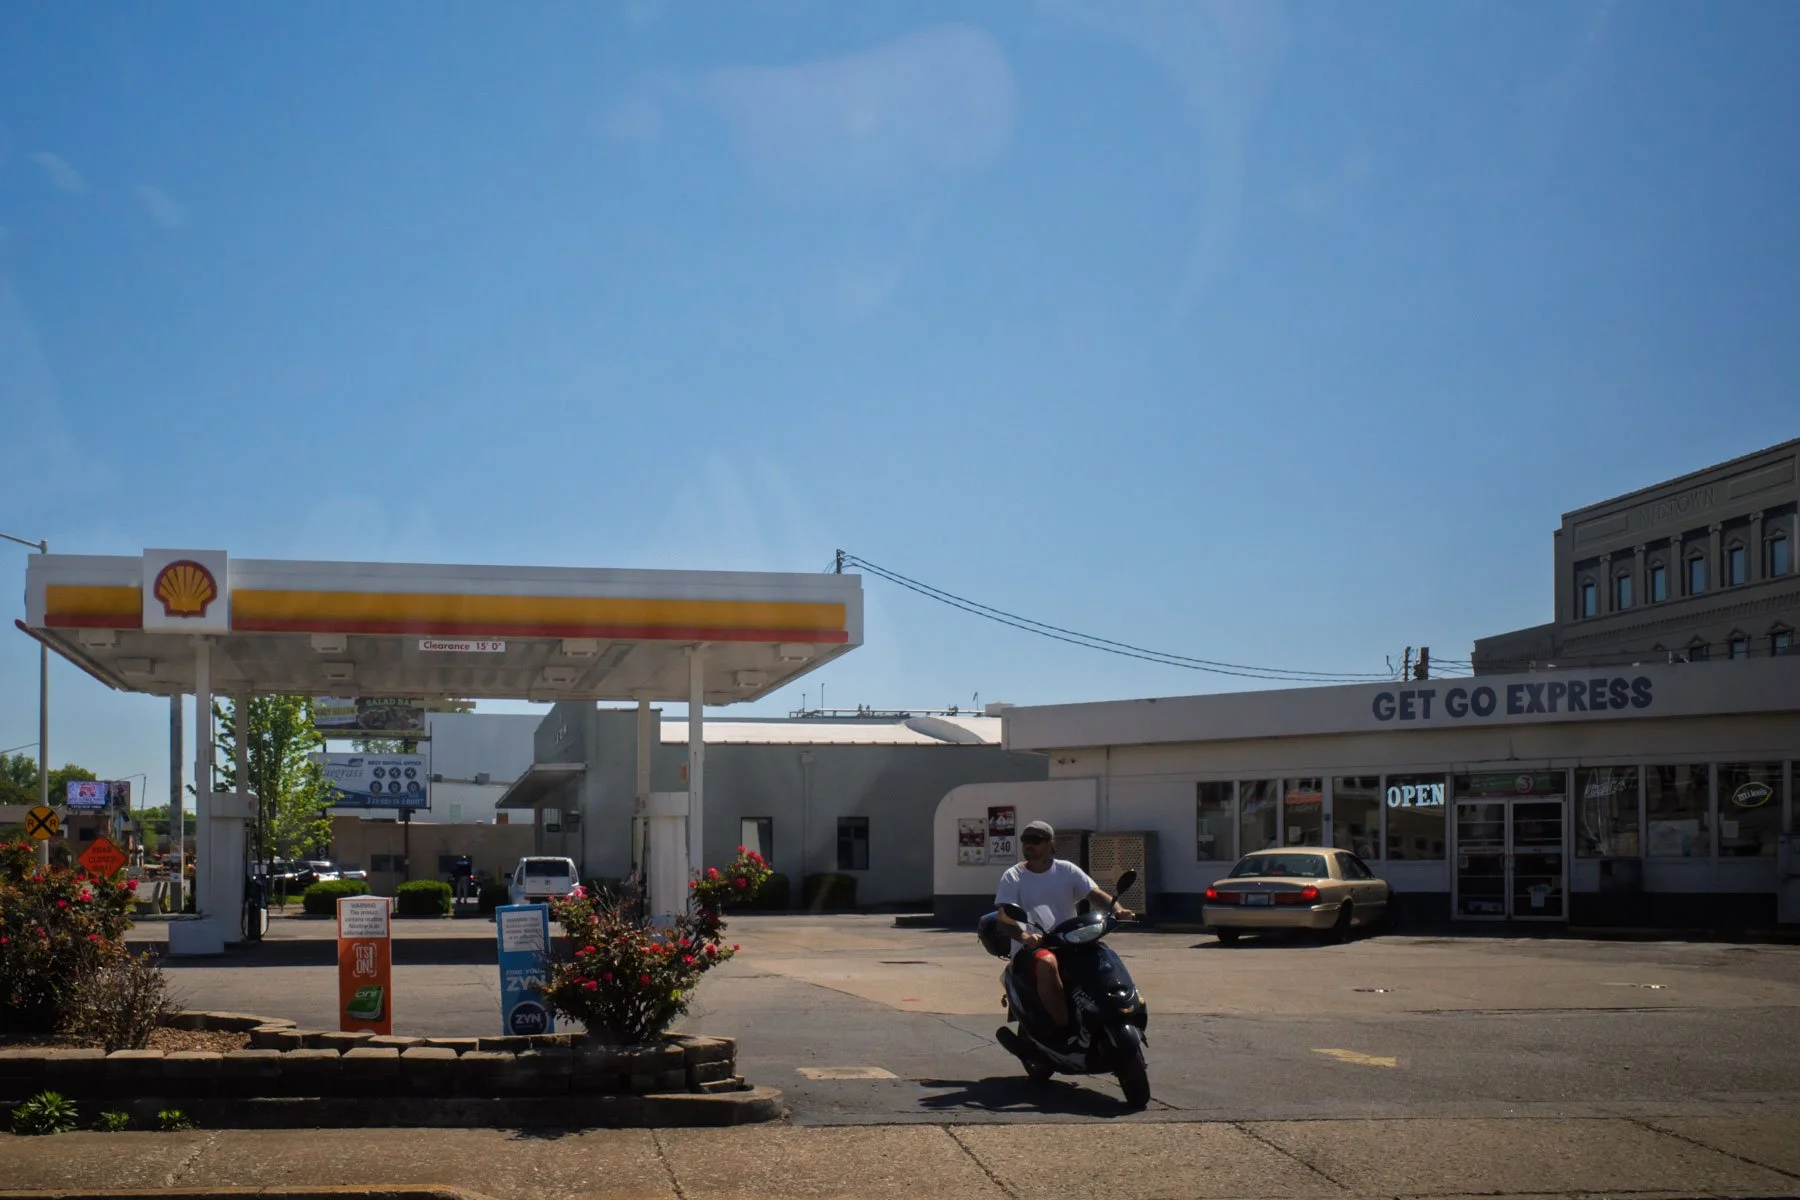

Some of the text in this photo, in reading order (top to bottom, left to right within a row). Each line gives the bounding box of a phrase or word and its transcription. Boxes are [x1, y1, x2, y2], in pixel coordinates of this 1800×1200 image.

[423, 641, 470, 650] Clearance
[366, 698, 396, 706] SALAD
[1372, 676, 1653, 721] GET GO EXPRESS
[1386, 784, 1445, 807] OPEN
[28, 819, 56, 828] R R
[507, 975, 547, 991] ZYN
[515, 1013, 541, 1025] ZYN
